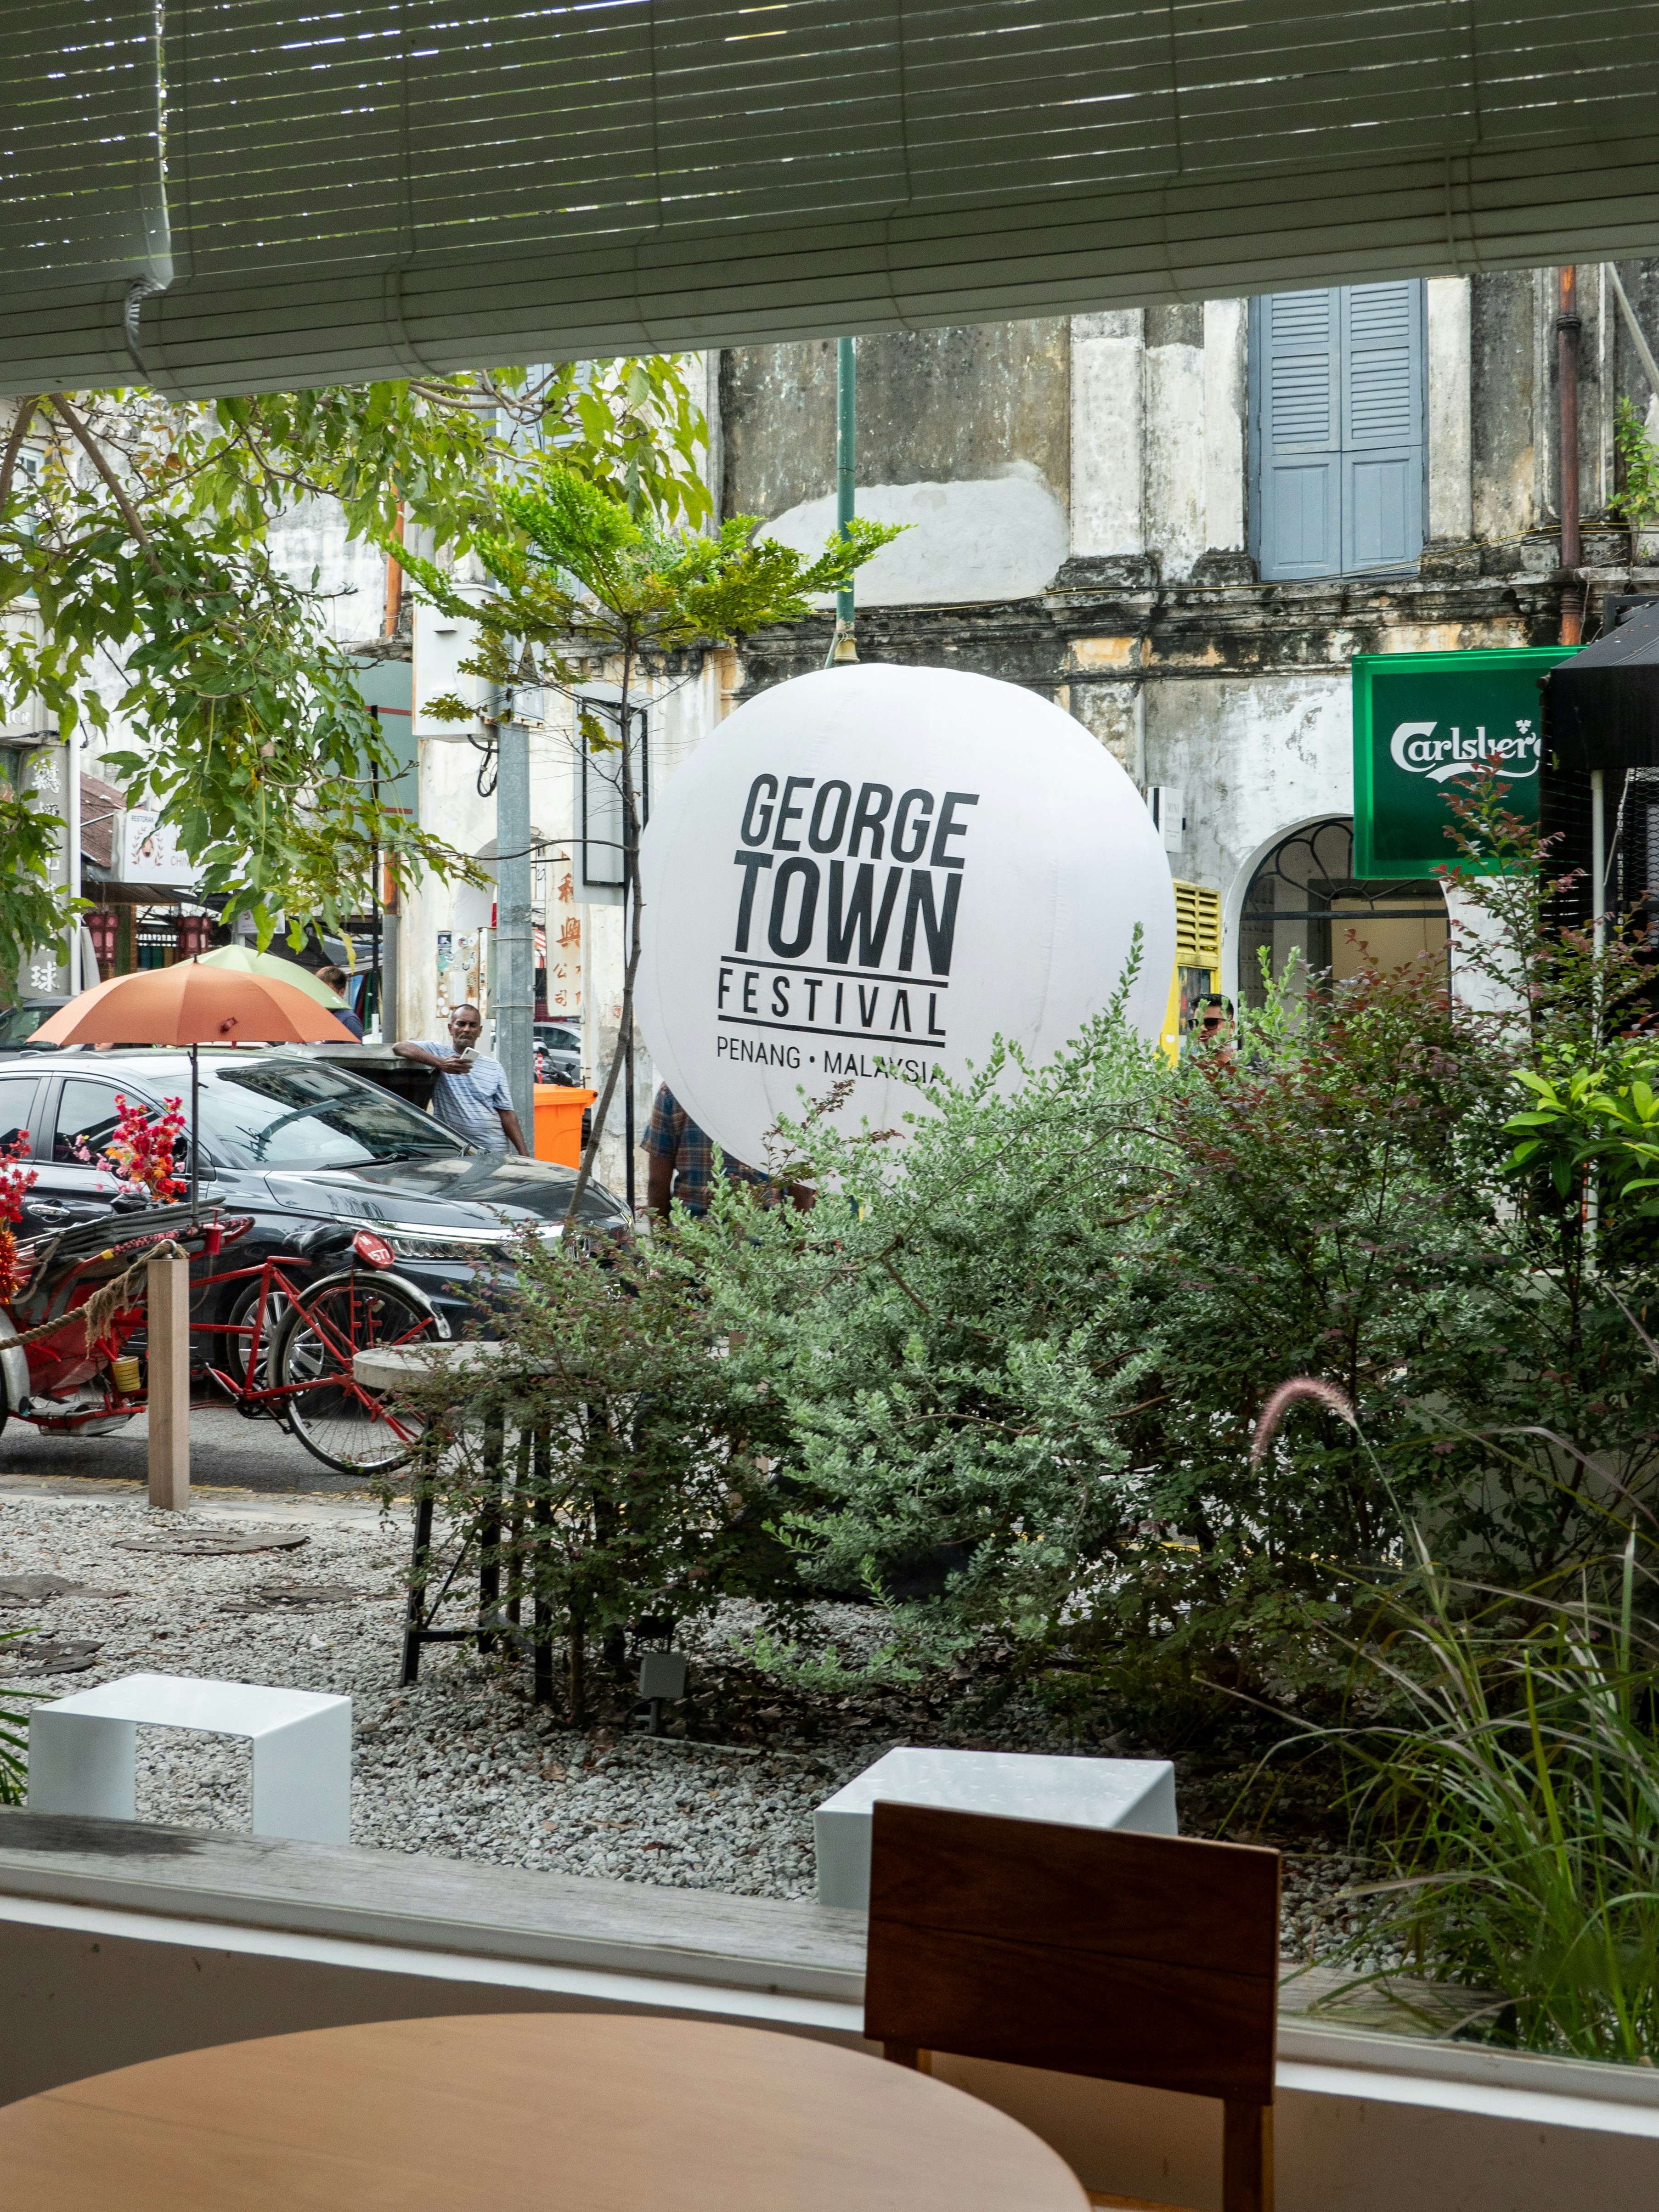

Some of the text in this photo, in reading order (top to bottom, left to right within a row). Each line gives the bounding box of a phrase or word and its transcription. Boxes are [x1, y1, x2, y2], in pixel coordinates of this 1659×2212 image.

[741, 773, 980, 869] GEORGE
[734, 850, 963, 976] TOWN
[718, 968, 946, 1036] FESTIVAL
[717, 1036, 800, 1069] PENANG
